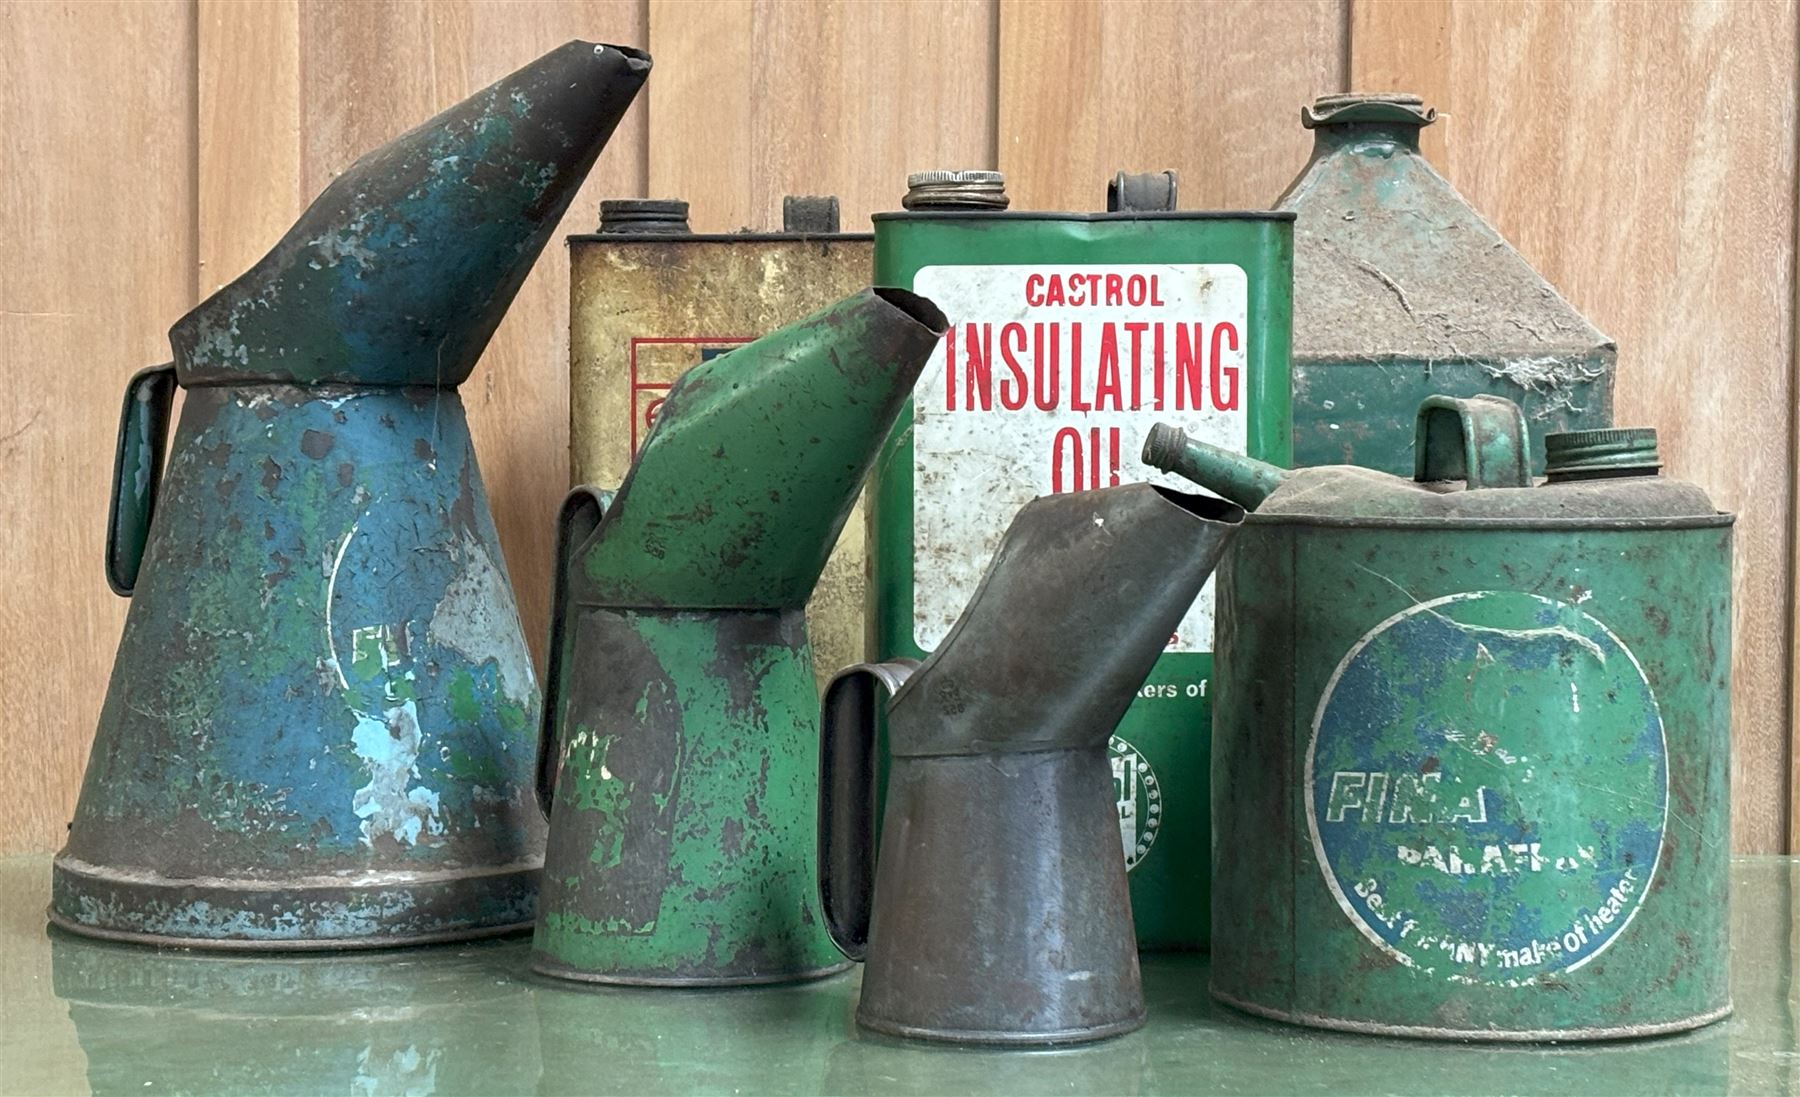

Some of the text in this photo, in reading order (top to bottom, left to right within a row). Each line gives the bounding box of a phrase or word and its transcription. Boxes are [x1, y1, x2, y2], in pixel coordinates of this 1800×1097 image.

[1026, 274, 1162, 306] CASTROL
[946, 322, 1238, 411] INSULATING
[1138, 680, 1206, 697] ers of
[1584, 868, 1638, 935] heater
